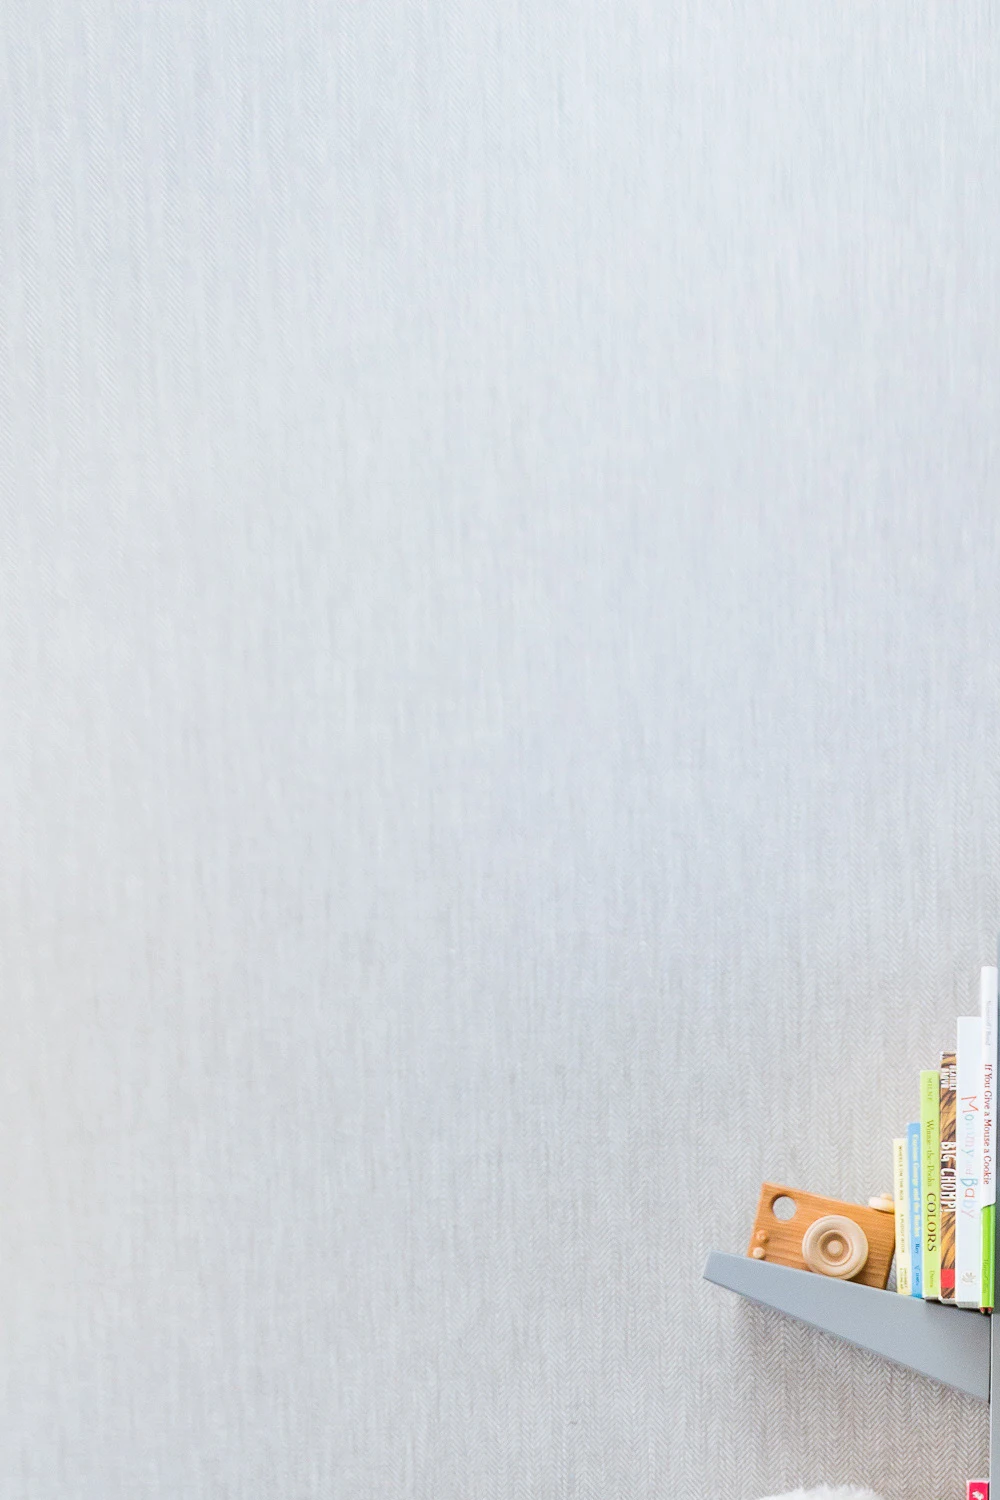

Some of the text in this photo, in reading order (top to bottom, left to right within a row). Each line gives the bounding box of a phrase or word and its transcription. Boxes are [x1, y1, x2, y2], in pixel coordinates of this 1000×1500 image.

[984, 1063, 993, 1071] If
[984, 1071, 993, 1092] You
[984, 1090, 993, 1110] Give
[960, 1095, 979, 1157] Mommy
[983, 1118, 992, 1147] Mouse
[940, 1141, 957, 1212] BIG CHOMP!
[983, 1155, 992, 1185] Cookie
[960, 1177, 979, 1220] Baby
[926, 1192, 937, 1252] COLORS
